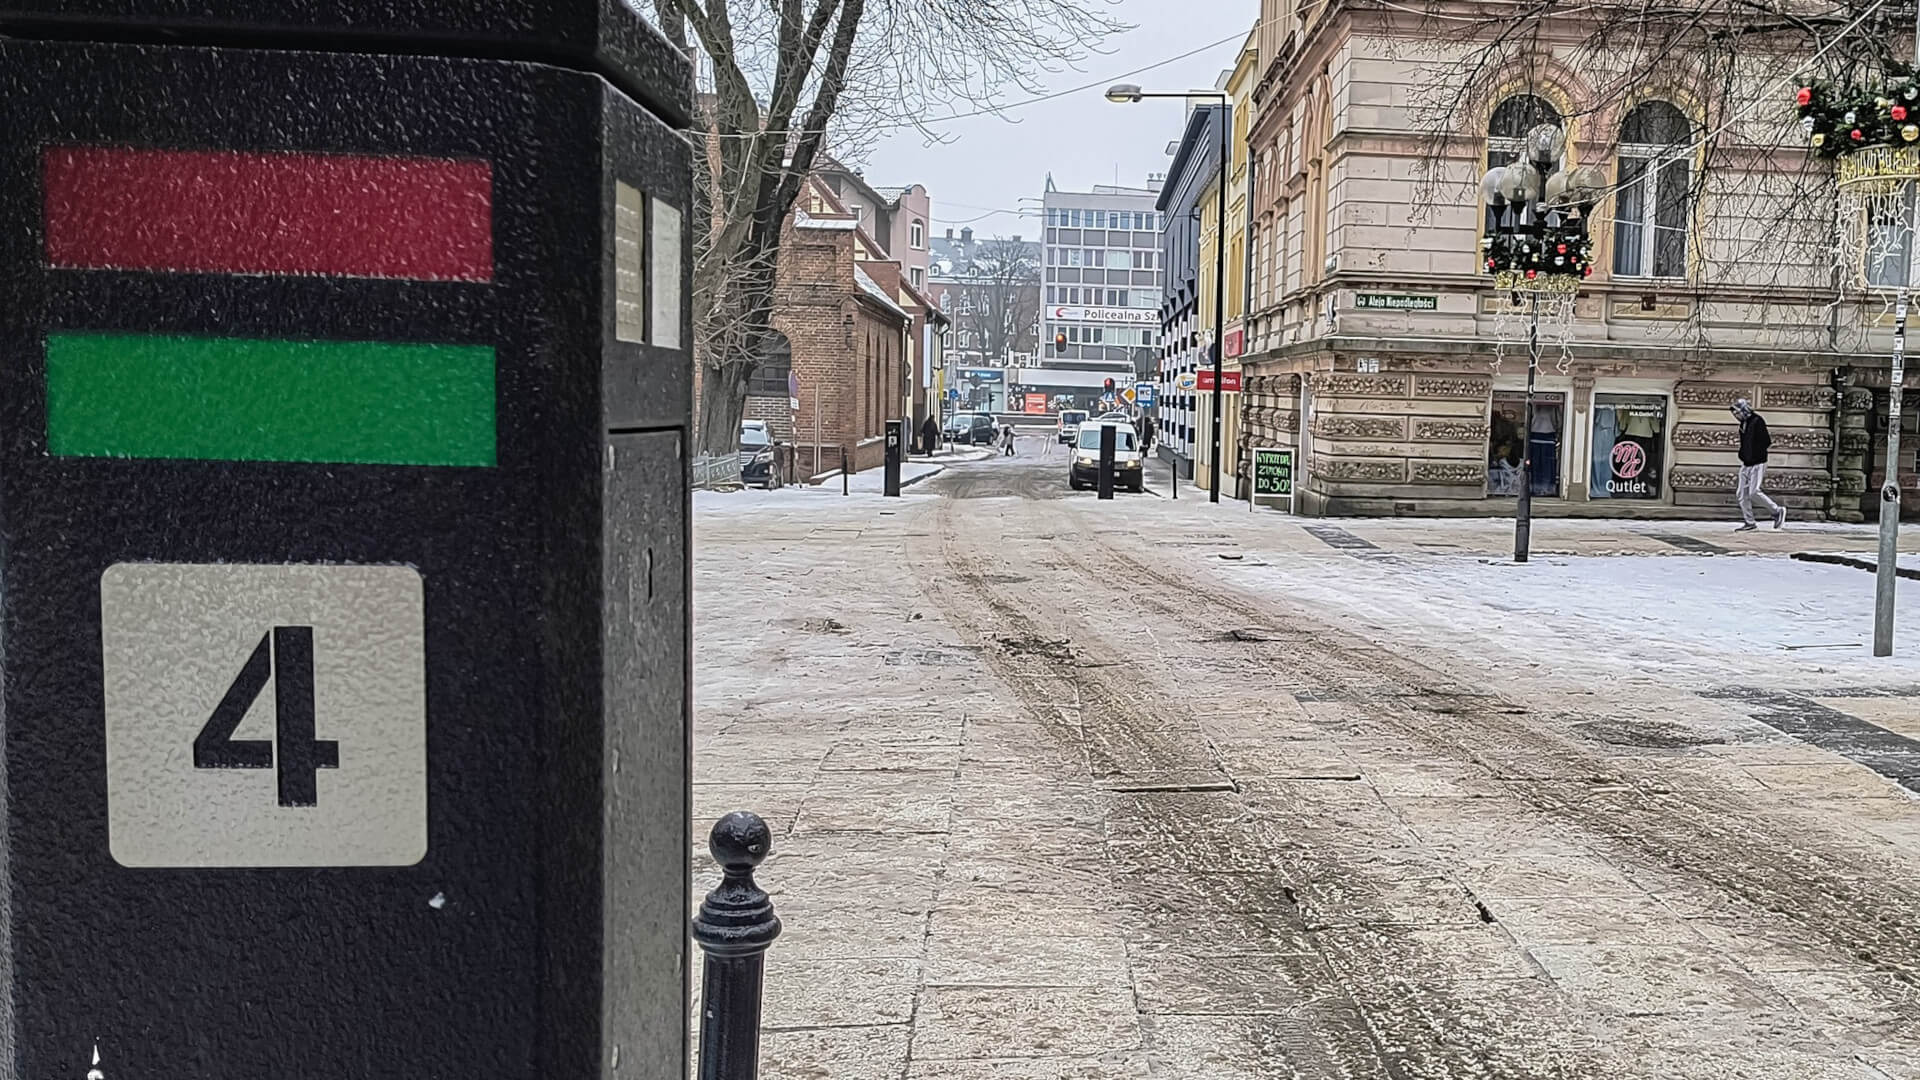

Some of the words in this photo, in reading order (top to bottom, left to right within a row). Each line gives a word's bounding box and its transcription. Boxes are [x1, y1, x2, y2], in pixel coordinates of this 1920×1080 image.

[1368, 296, 1385, 308] Aleja
[1084, 309, 1141, 320] Policealna
[1202, 376, 1237, 385] amifon
[1258, 477, 1270, 489] DO
[193, 625, 340, 808] 4
